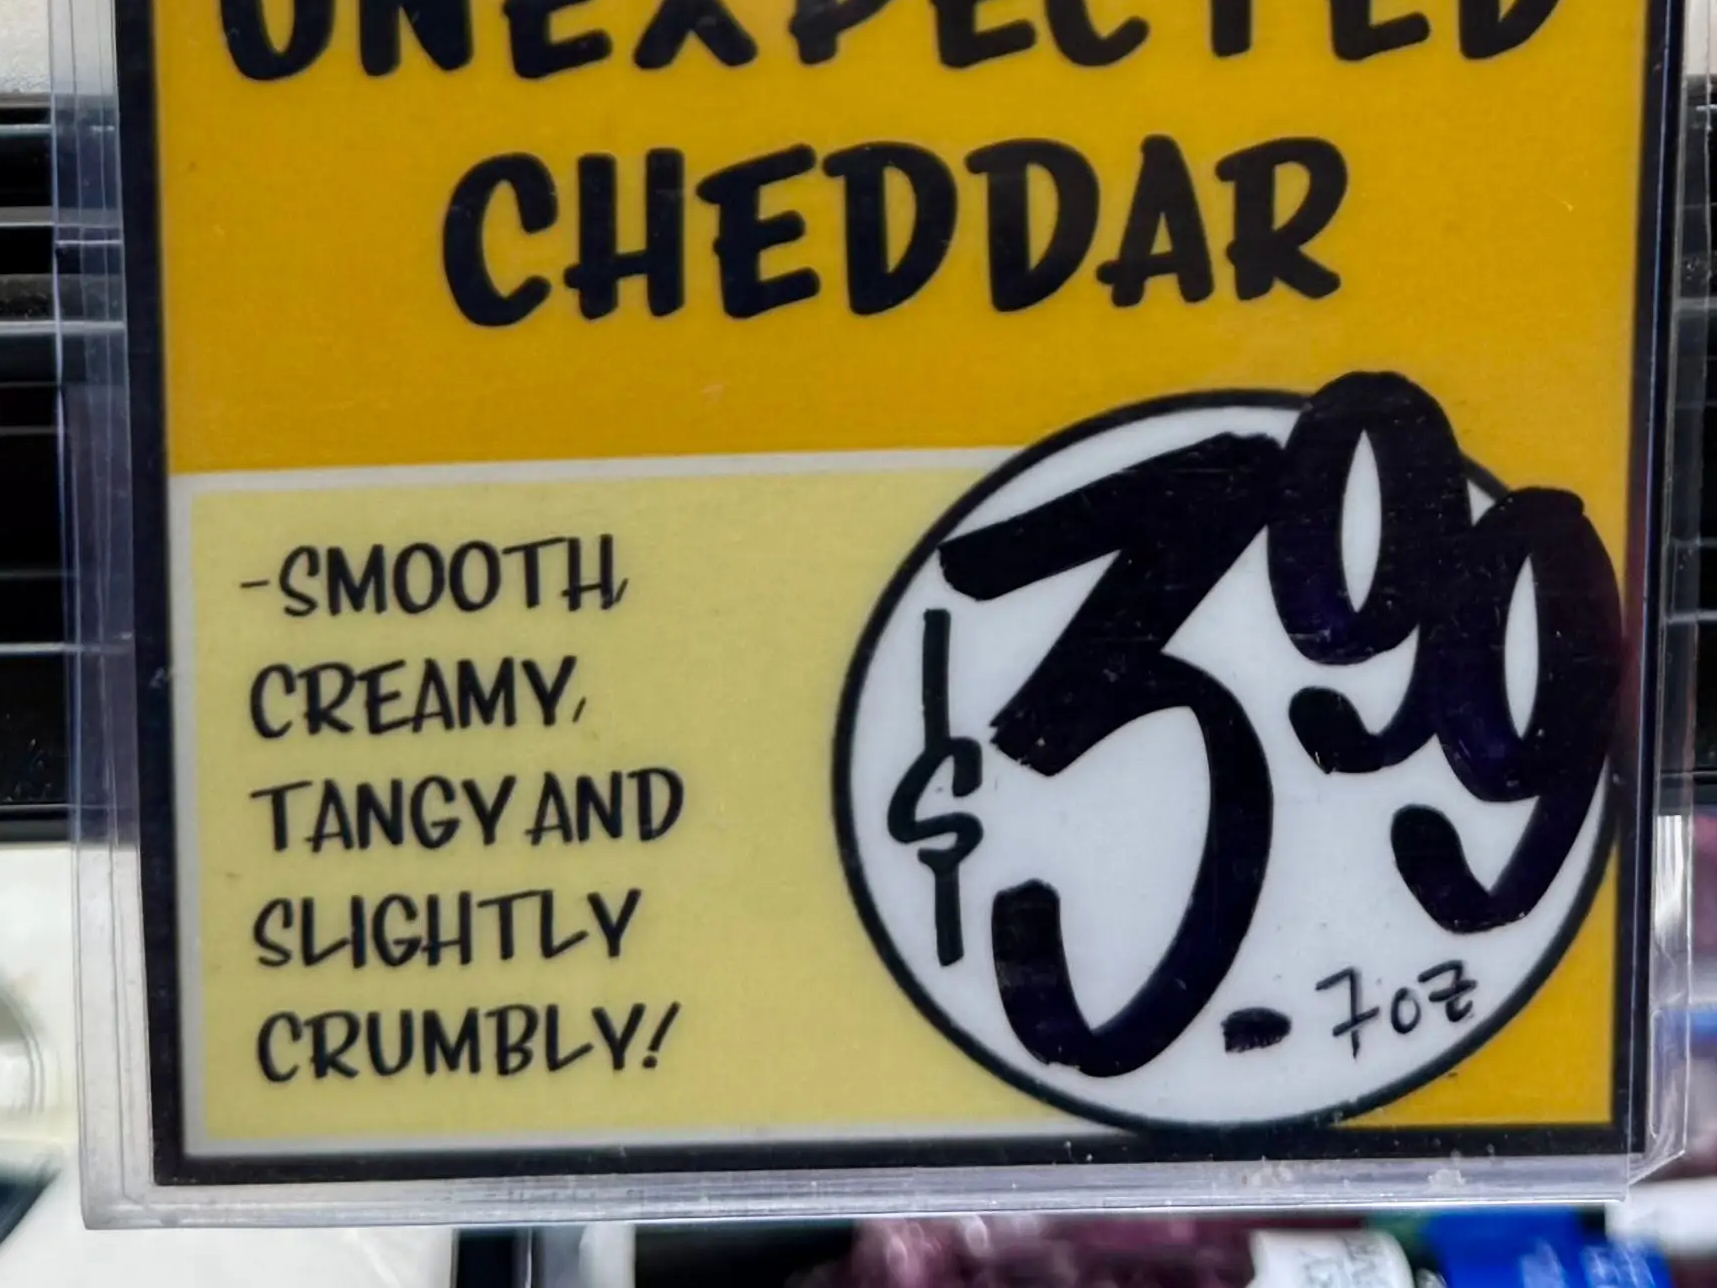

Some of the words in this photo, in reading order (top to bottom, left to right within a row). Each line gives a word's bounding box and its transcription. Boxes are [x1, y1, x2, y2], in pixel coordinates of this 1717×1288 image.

[439, 132, 1353, 329] CHEDDAR
[249, 654, 587, 740] CREAMY,
[249, 773, 517, 853] TANGY
[524, 767, 685, 846] AND
[251, 887, 643, 970] SLIGHTLY
[255, 1000, 682, 1084] CRUMBLY!
